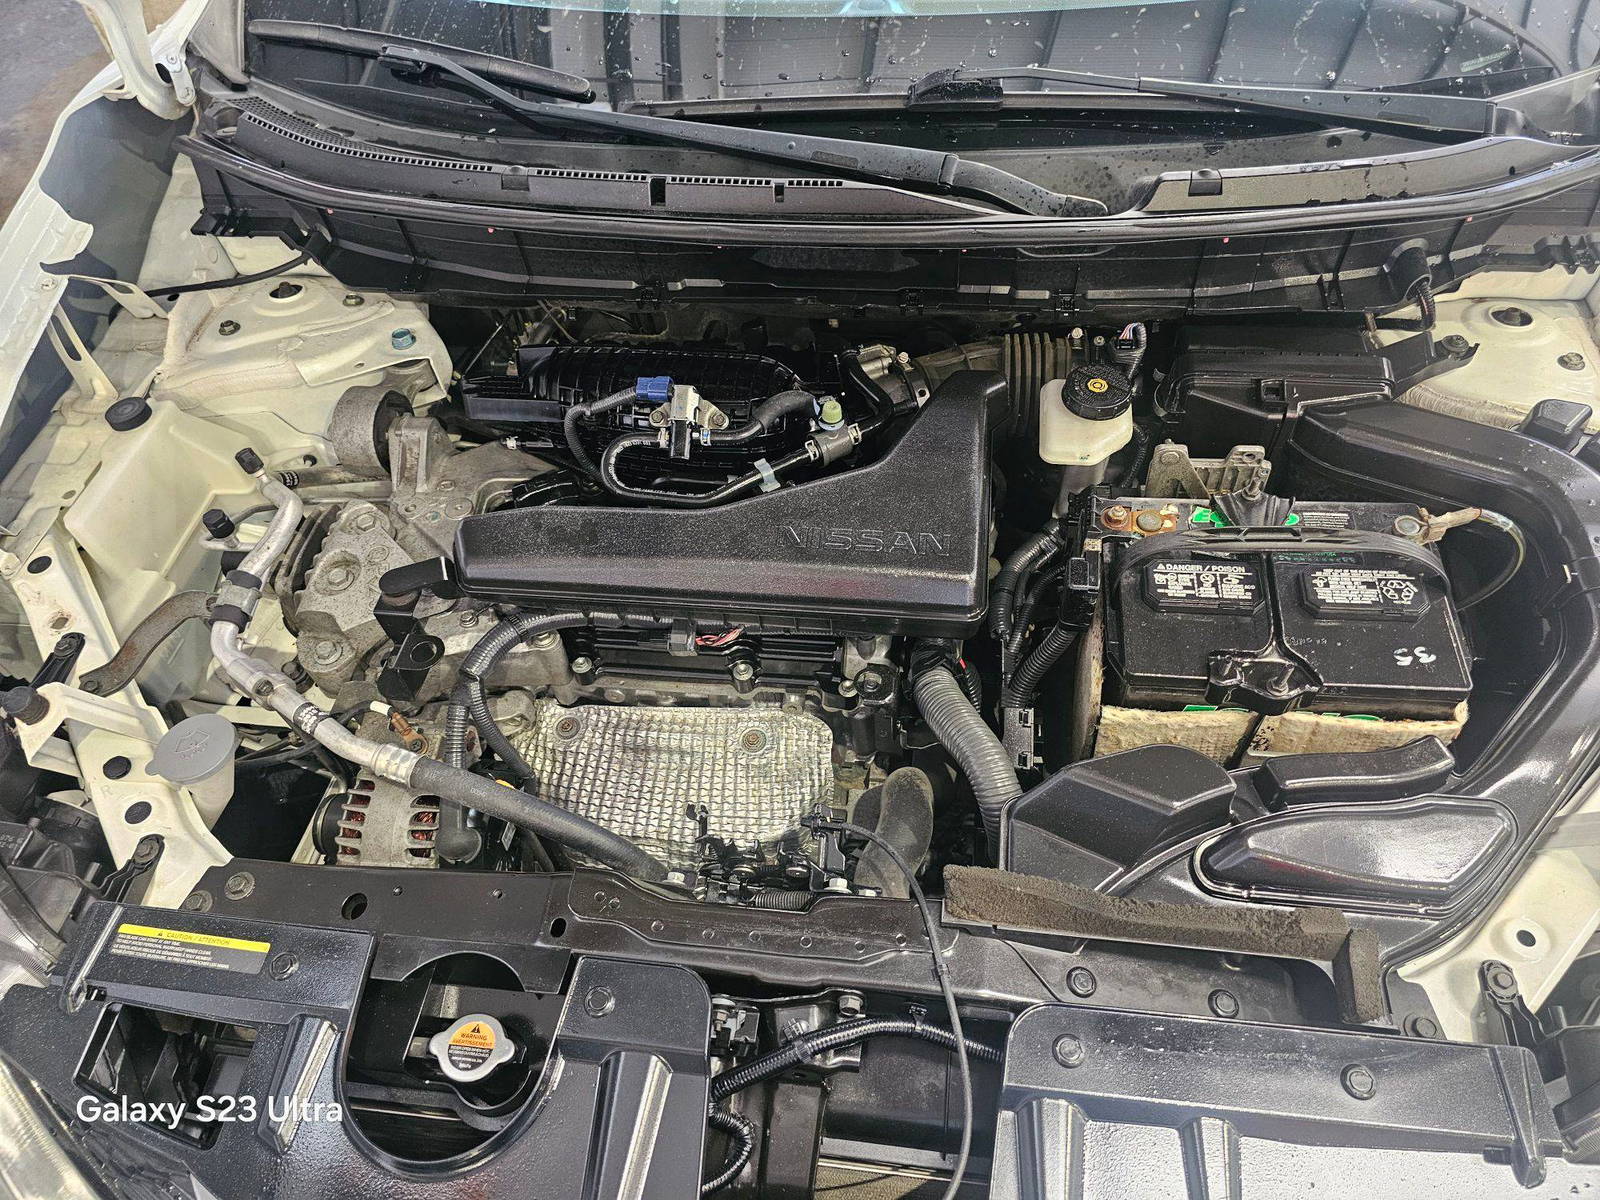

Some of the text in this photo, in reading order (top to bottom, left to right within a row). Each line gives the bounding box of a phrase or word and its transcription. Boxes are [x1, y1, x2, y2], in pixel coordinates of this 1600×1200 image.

[776, 525, 951, 556] NISSAN
[167, 932, 193, 941] CAUTION
[200, 936, 230, 945] ATTENTION
